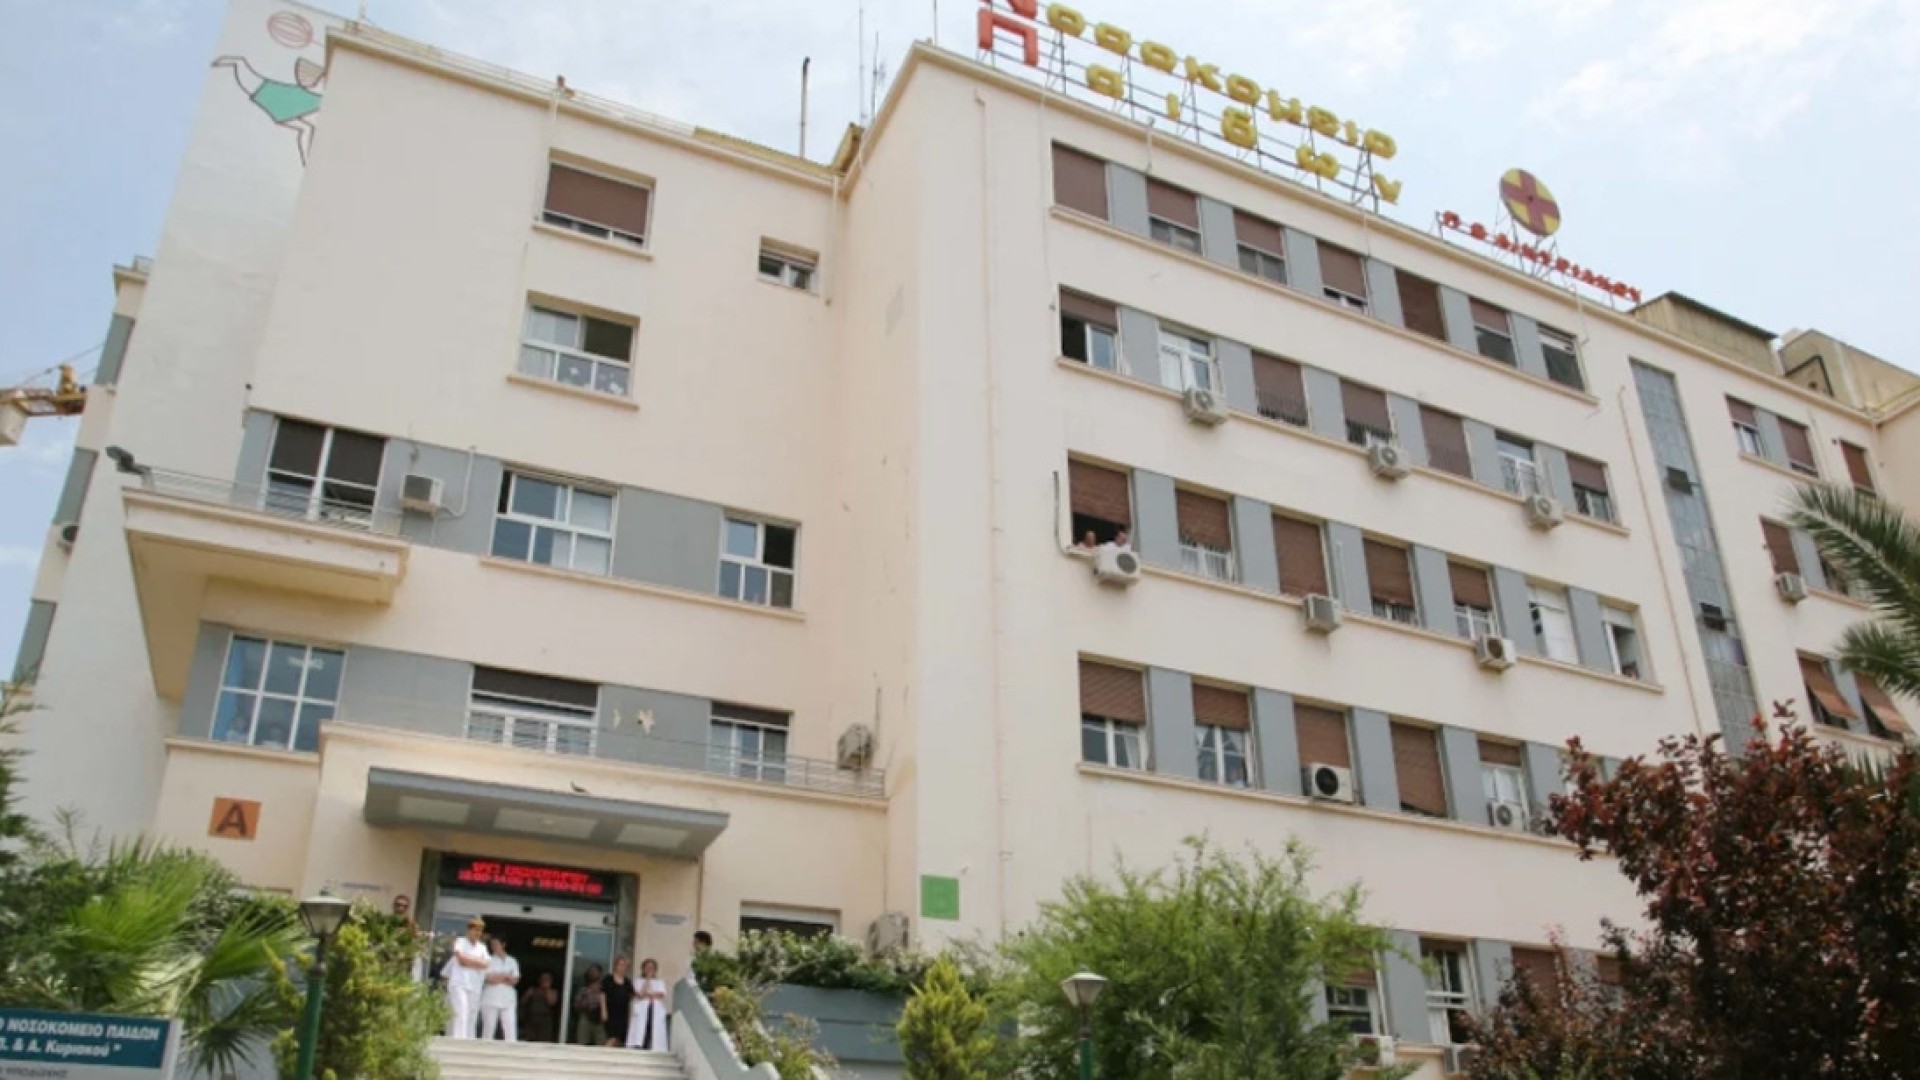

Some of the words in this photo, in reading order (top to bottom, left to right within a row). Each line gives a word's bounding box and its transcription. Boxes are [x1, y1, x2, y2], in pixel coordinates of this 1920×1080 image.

[216, 802, 247, 835] Α
[8, 1018, 103, 1036] ΝΟΣΟΚΟΜΕΙΟ
[107, 1025, 159, 1040] ΠΑΙΔΩΝ
